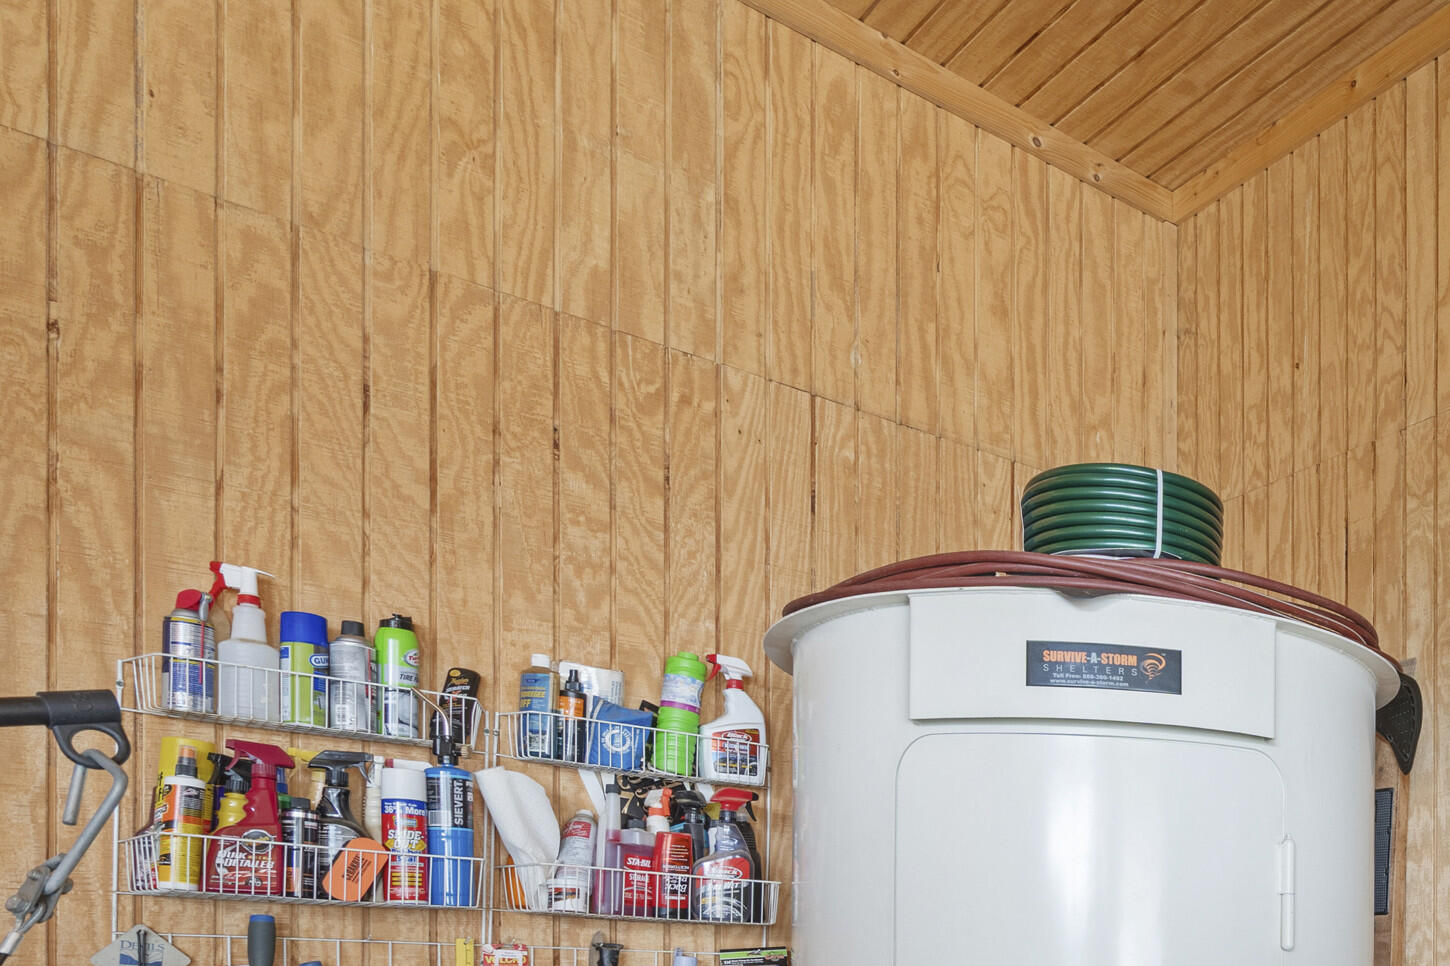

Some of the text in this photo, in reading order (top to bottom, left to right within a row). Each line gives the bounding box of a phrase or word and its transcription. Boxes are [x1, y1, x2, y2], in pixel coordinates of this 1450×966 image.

[1042, 650, 1138, 667] SURVIVE-A-STORM
[1042, 663, 1138, 677] SHELTERS
[454, 779, 464, 826] SIEVERT
[405, 805, 426, 816] More
